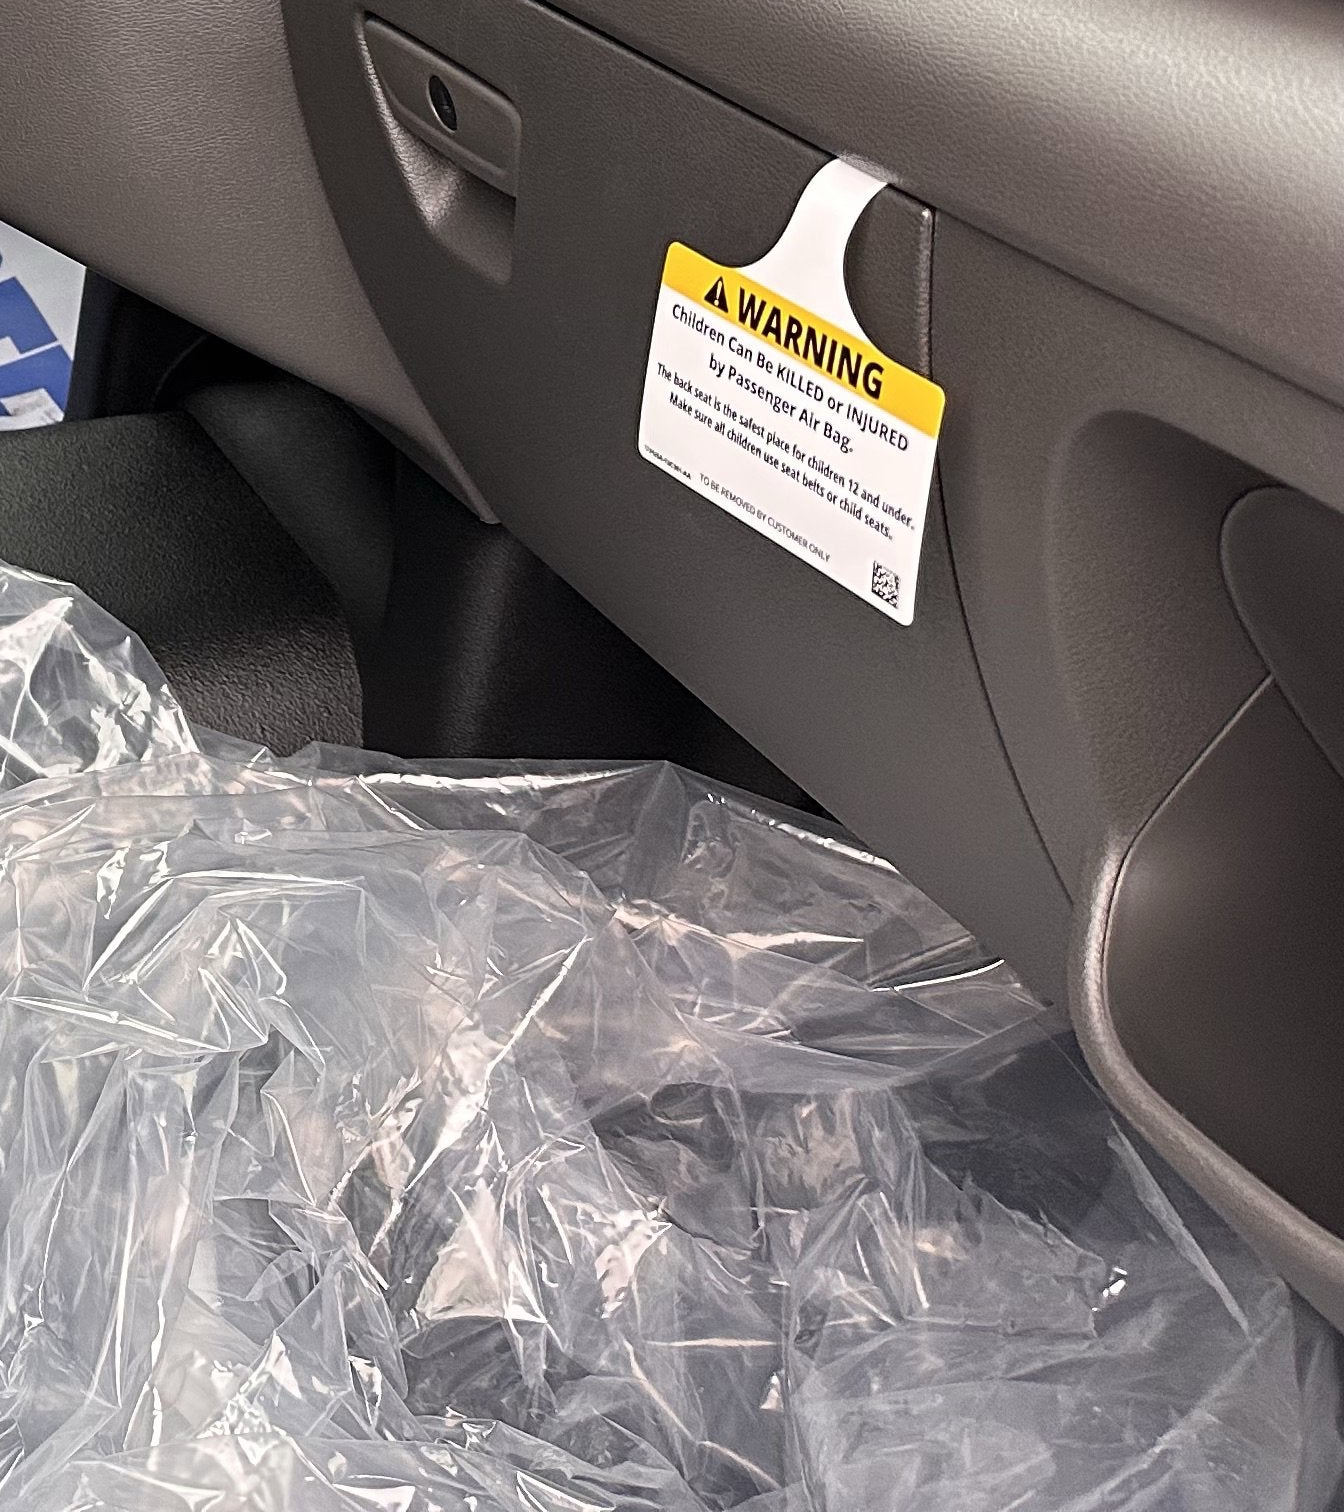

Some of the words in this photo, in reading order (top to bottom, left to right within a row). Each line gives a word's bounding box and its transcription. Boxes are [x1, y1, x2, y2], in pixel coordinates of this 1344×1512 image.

[672, 303, 725, 346] Children
[728, 336, 753, 362] Can
[756, 351, 774, 374] Be
[776, 362, 824, 402] KILLED
[827, 396, 844, 414] or
[846, 403, 910, 452] INJURED
[709, 352, 726, 378] by
[728, 365, 797, 417] Passenger
[798, 408, 821, 432] Air
[823, 421, 854, 454] Bag.
[738, 286, 885, 400] WARNING
[657, 362, 672, 382] The
[673, 372, 693, 395] back
[694, 387, 713, 407] seat
[714, 396, 722, 412] is
[723, 403, 738, 422] the
[739, 415, 765, 438] safest
[766, 431, 790, 454] place
[792, 444, 806, 463] for
[807, 455, 845, 488] children
[848, 478, 859, 497] 12
[860, 489, 880, 509] and
[882, 501, 915, 530] under.
[669, 391, 693, 416] Make
[694, 409, 713, 429] sure
[714, 420, 726, 436] all
[726, 428, 762, 458] children
[763, 451, 779, 469] use
[781, 462, 800, 483] seat
[802, 471, 825, 498] belts
[826, 490, 838, 505] or
[839, 497, 863, 521] child
[864, 513, 894, 540] seats.
[699, 473, 710, 487] TO
[710, 480, 720, 494] BE
[720, 486, 756, 516] REMOVED
[756, 509, 767, 522] BY
[767, 516, 809, 549] CUSTOMER
[809, 543, 831, 563] ONLY
